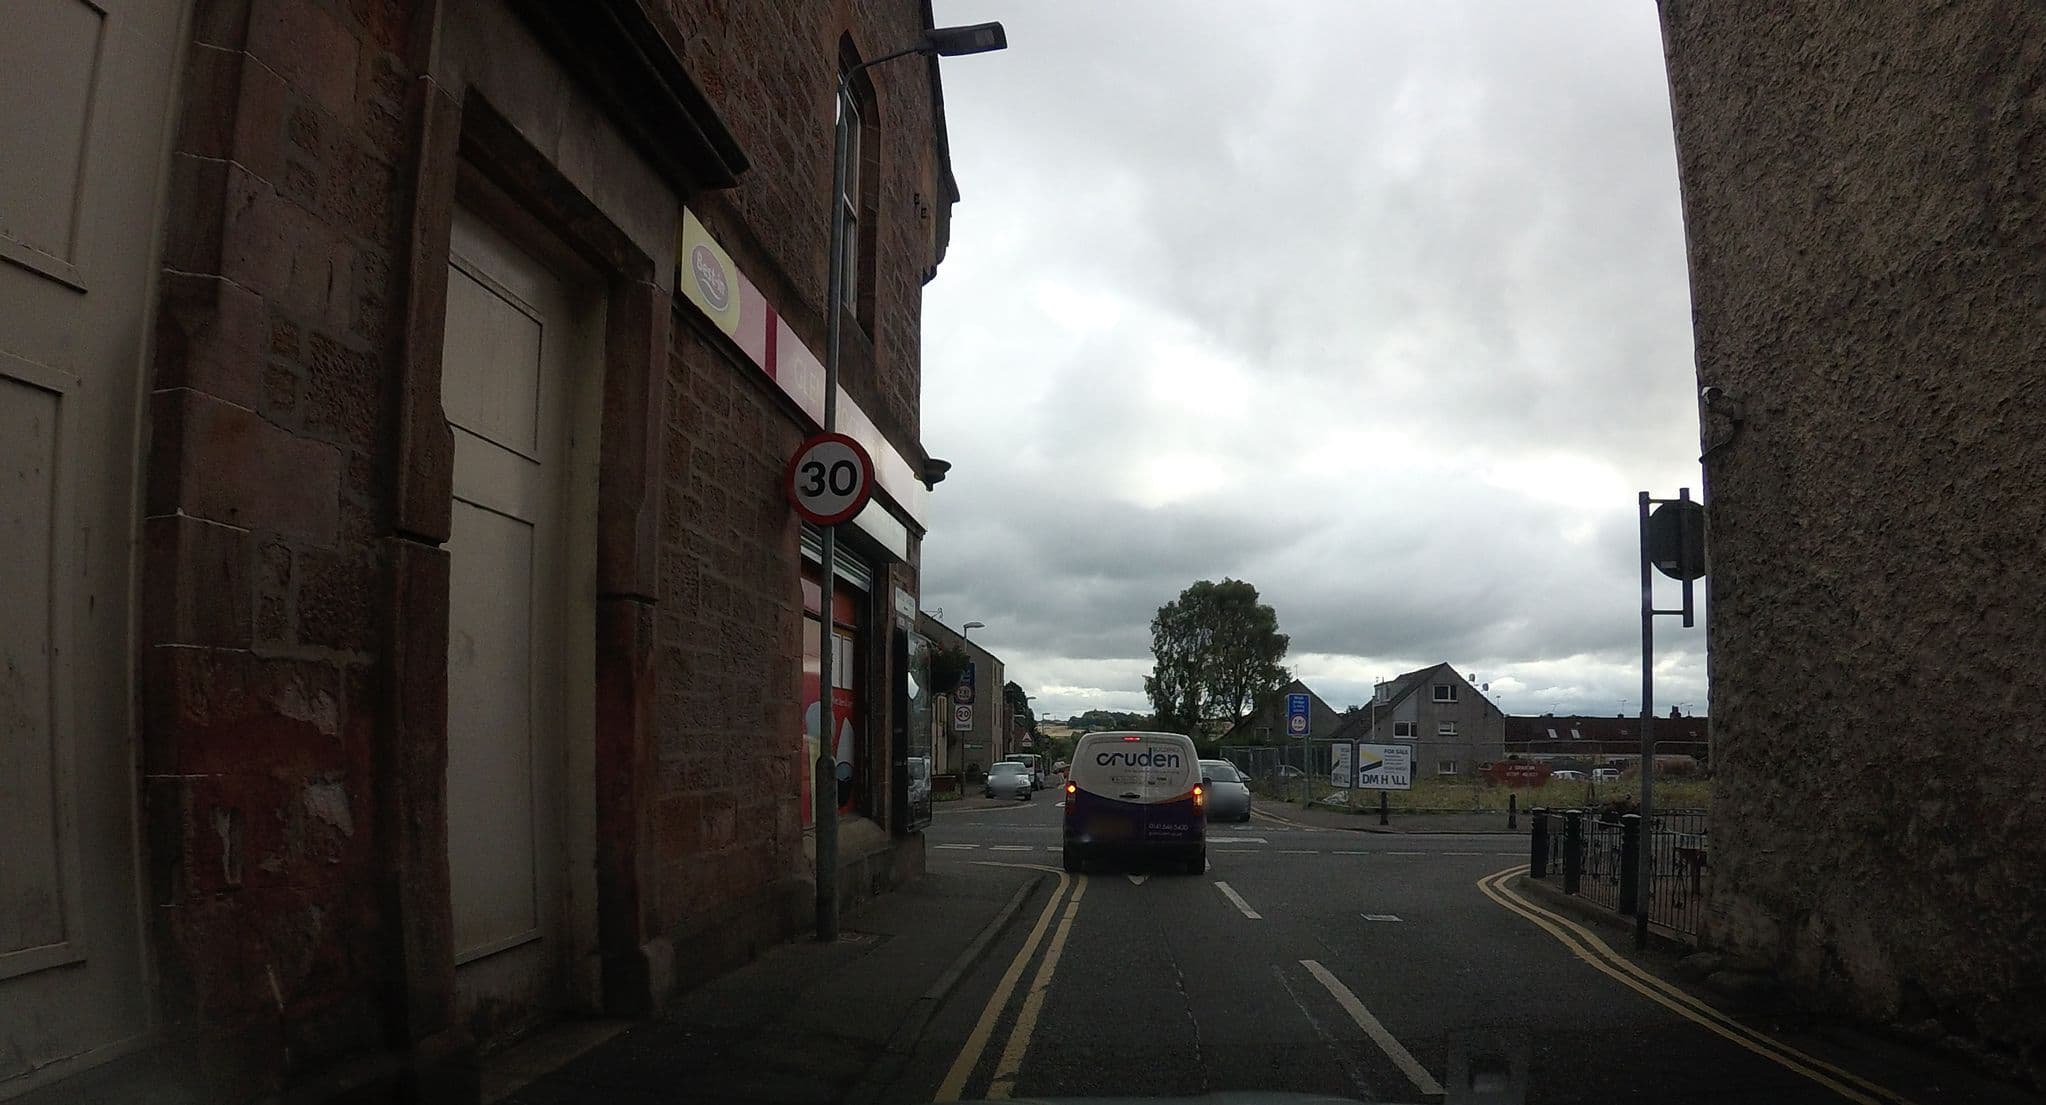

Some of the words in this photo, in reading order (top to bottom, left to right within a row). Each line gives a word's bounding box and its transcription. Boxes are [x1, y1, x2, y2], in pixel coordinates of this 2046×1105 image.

[801, 460, 857, 497] 30
[958, 710, 969, 718] 20
[1096, 747, 1180, 769] cruden
[1362, 774, 1379, 784] DM
